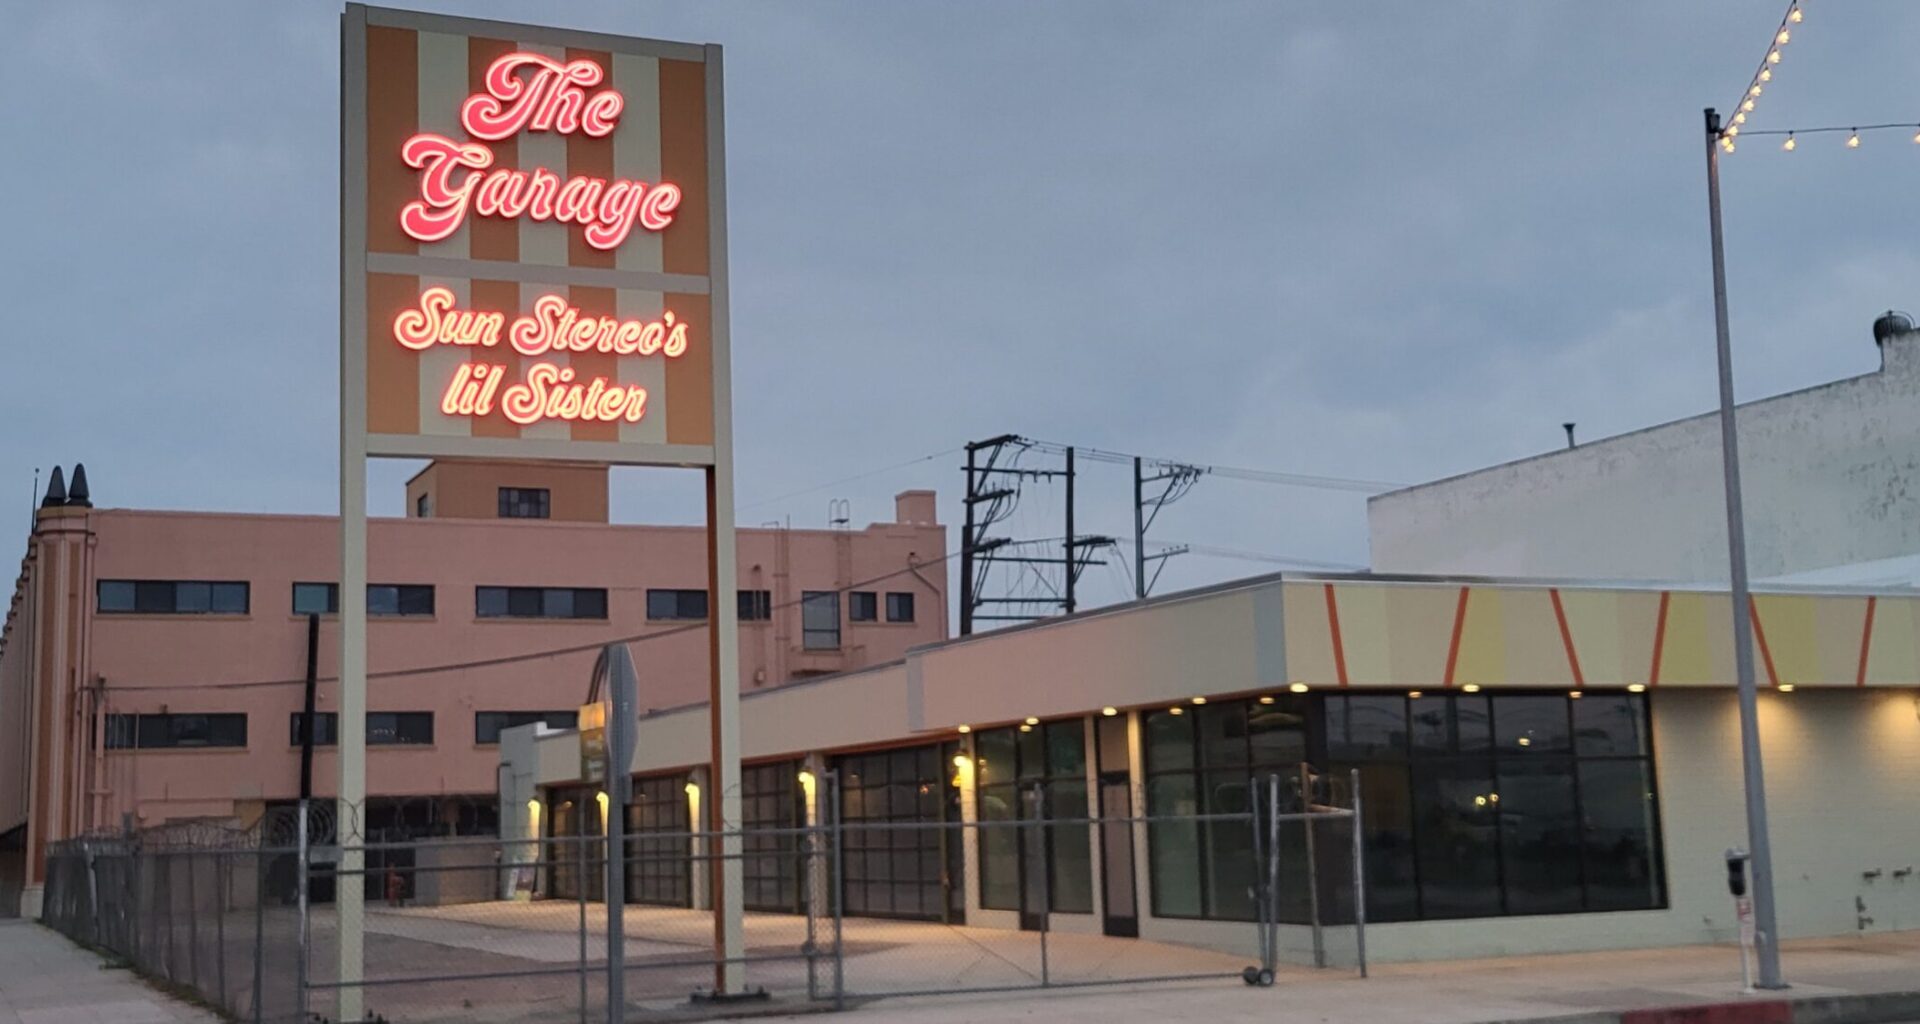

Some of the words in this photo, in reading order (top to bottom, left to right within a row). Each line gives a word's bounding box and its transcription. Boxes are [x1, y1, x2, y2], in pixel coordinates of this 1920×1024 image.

[462, 53, 624, 140] The
[401, 133, 681, 250] Garage
[394, 287, 505, 350] Sun
[509, 294, 688, 358] Stereo's
[441, 362, 506, 415] lil
[501, 362, 648, 424] Sister
